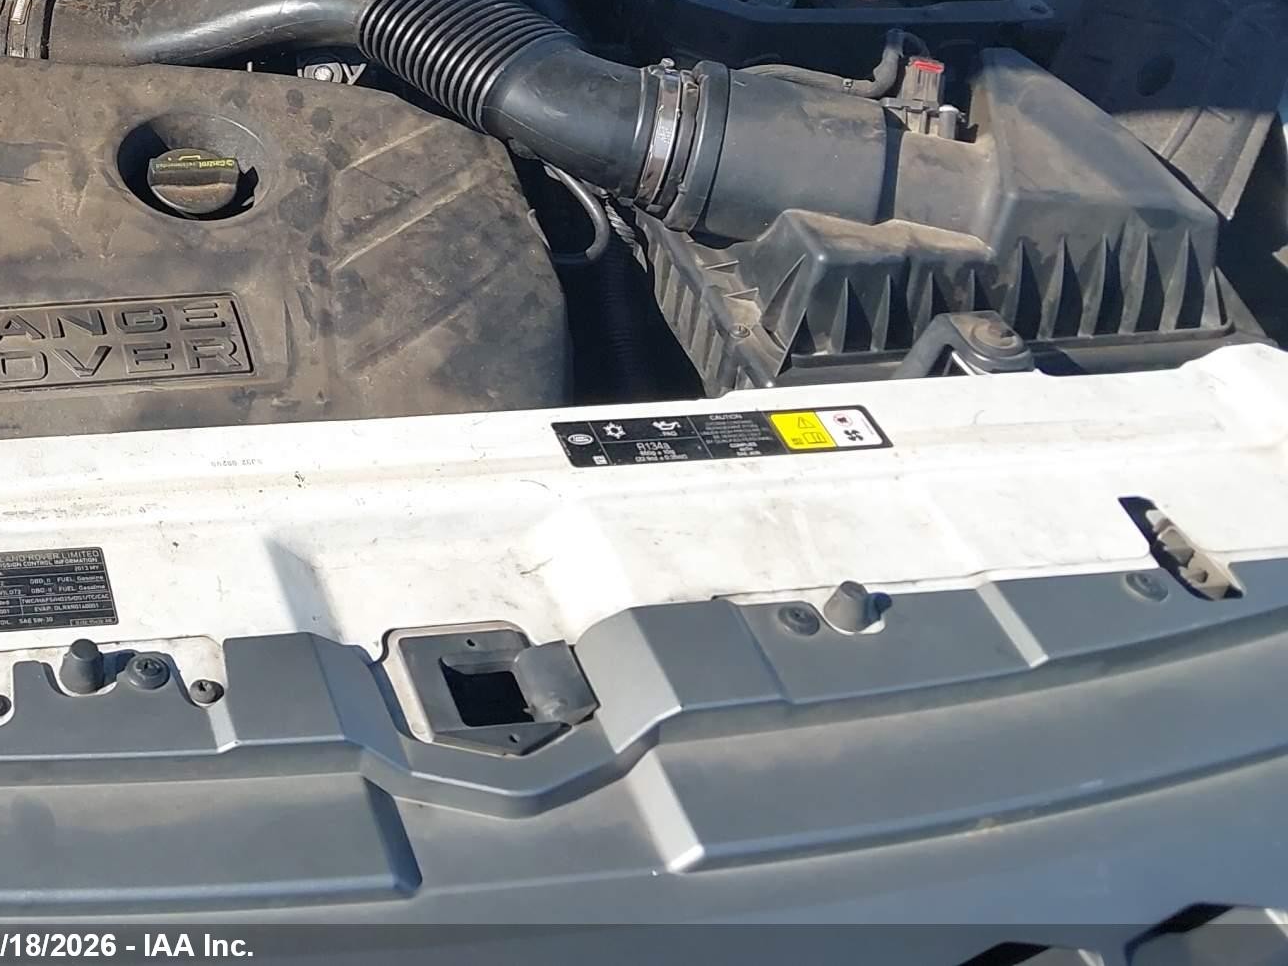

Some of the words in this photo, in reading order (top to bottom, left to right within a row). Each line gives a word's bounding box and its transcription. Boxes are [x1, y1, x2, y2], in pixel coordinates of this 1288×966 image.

[636, 442, 671, 451] R134a
[27, 552, 60, 562] ROVER
[62, 550, 100, 559] LIMITED
[53, 557, 98, 565] INFORMATION
